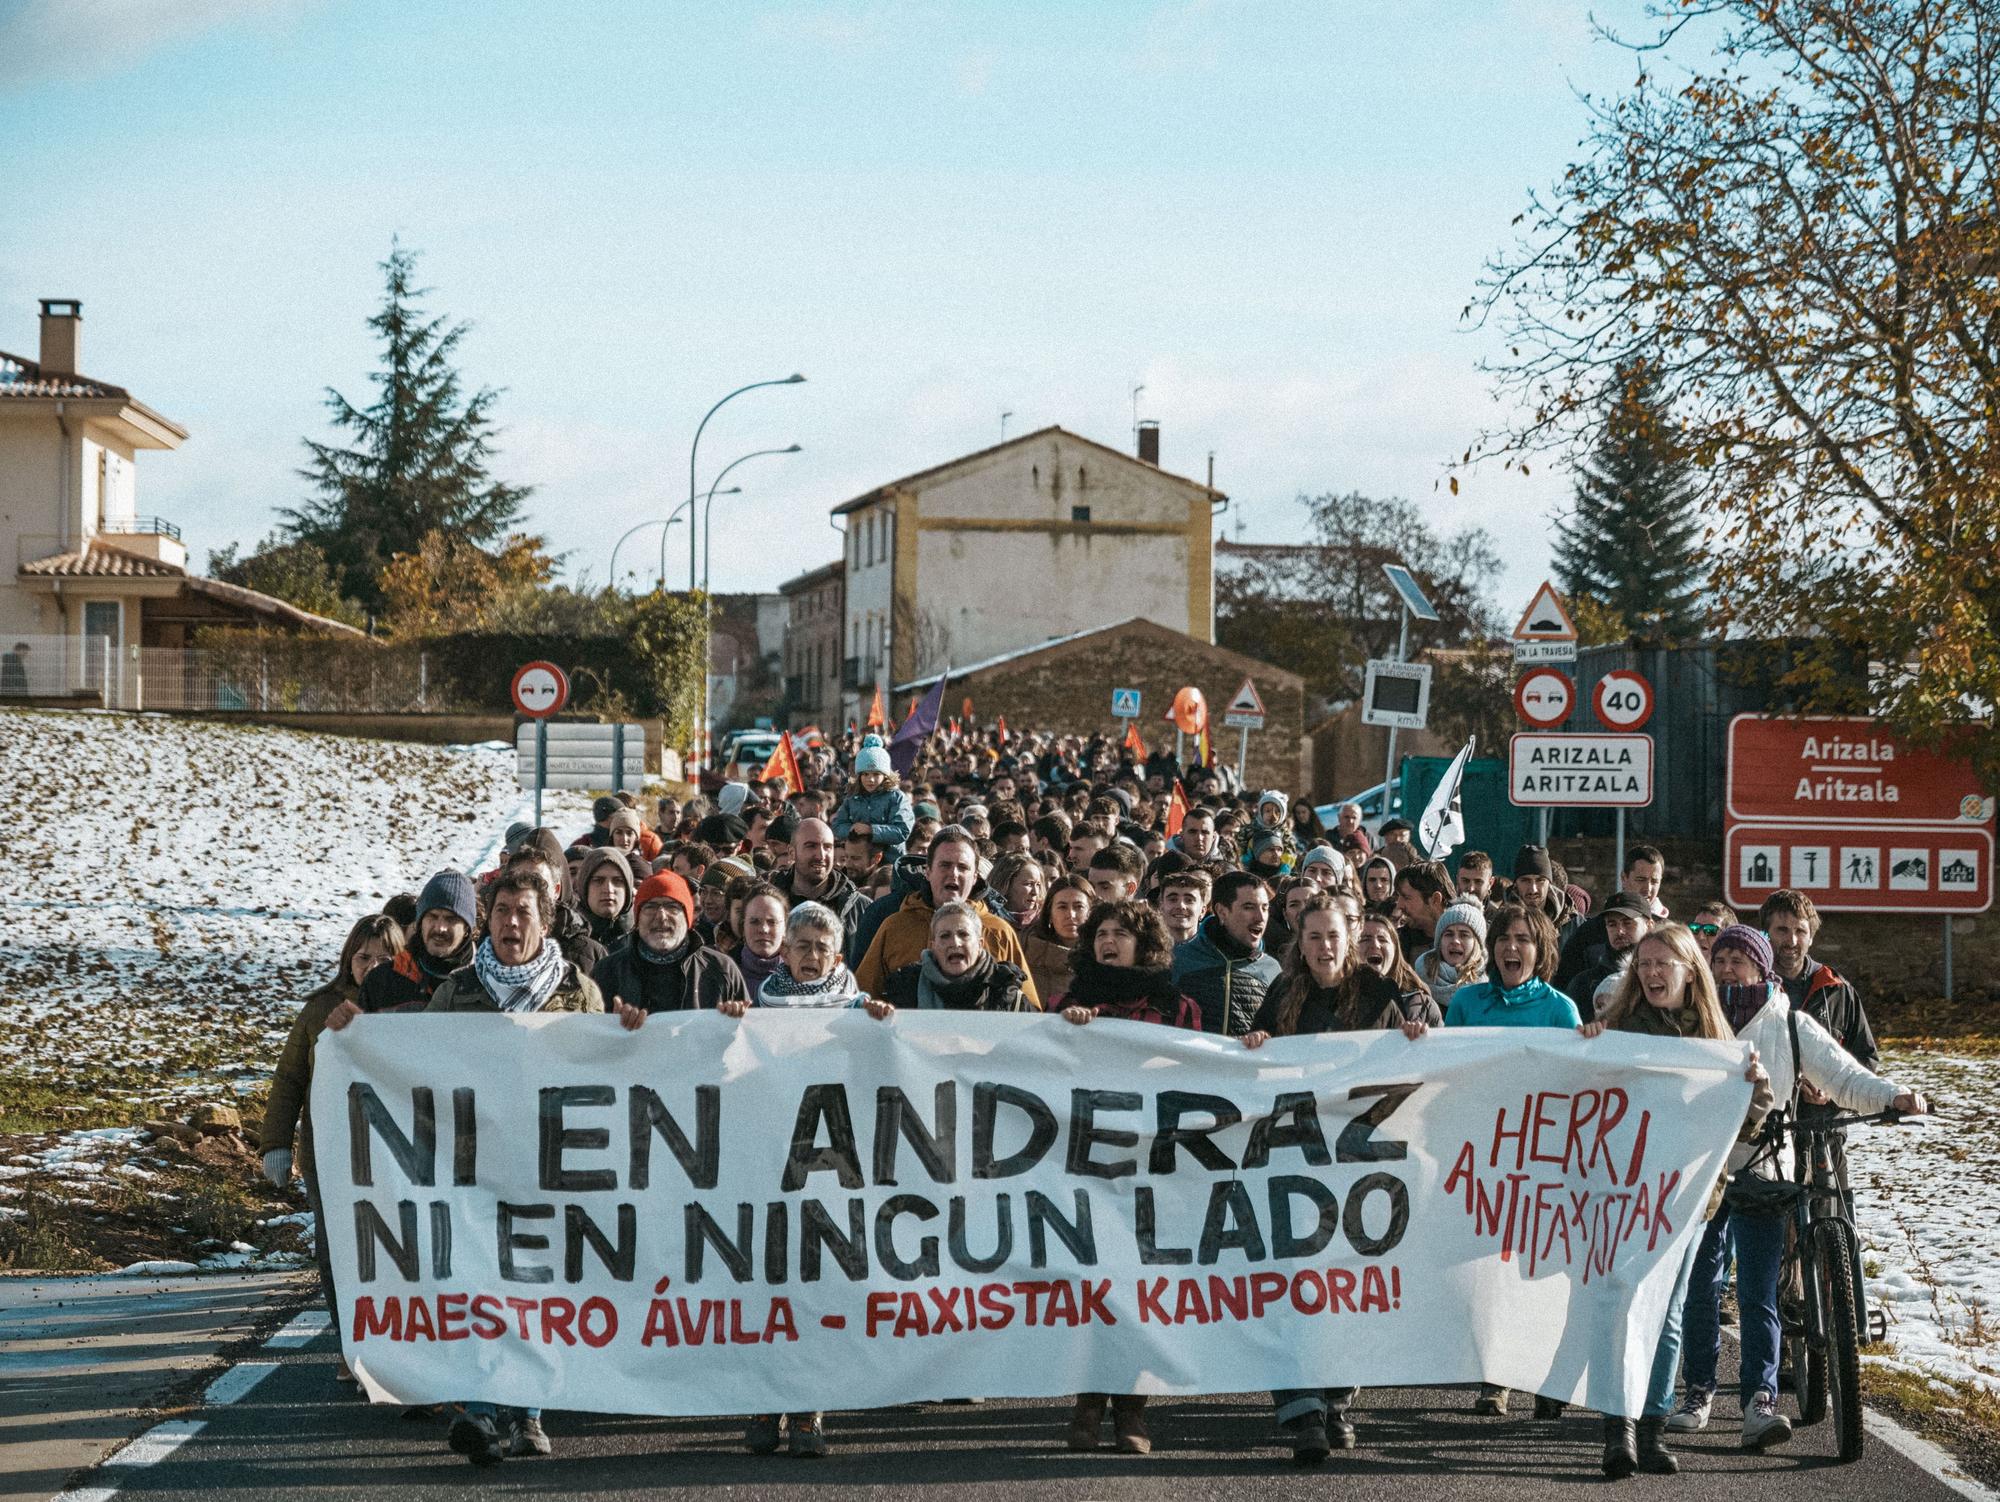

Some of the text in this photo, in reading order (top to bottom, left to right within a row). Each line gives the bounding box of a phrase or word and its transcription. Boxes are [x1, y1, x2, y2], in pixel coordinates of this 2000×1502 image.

[1606, 692, 1641, 711] 40
[1397, 714, 1422, 726] km/h
[1531, 747, 1633, 765] ARIZALA
[1801, 736, 1895, 761] Arizala
[1522, 776, 1640, 793] ARITZALA
[1794, 776, 1899, 802] Aritzala
[347, 1080, 1424, 1192] NI EN ANDERAZ
[1490, 1087, 1651, 1187] HERRI
[1444, 1141, 1680, 1285] ANTIFAXISTAK
[353, 1172, 1410, 1285] NI EN NINGUN LADO
[353, 1265, 1402, 1348] MAESTRO ÁVILA - FAXISTAK KANPORA!
